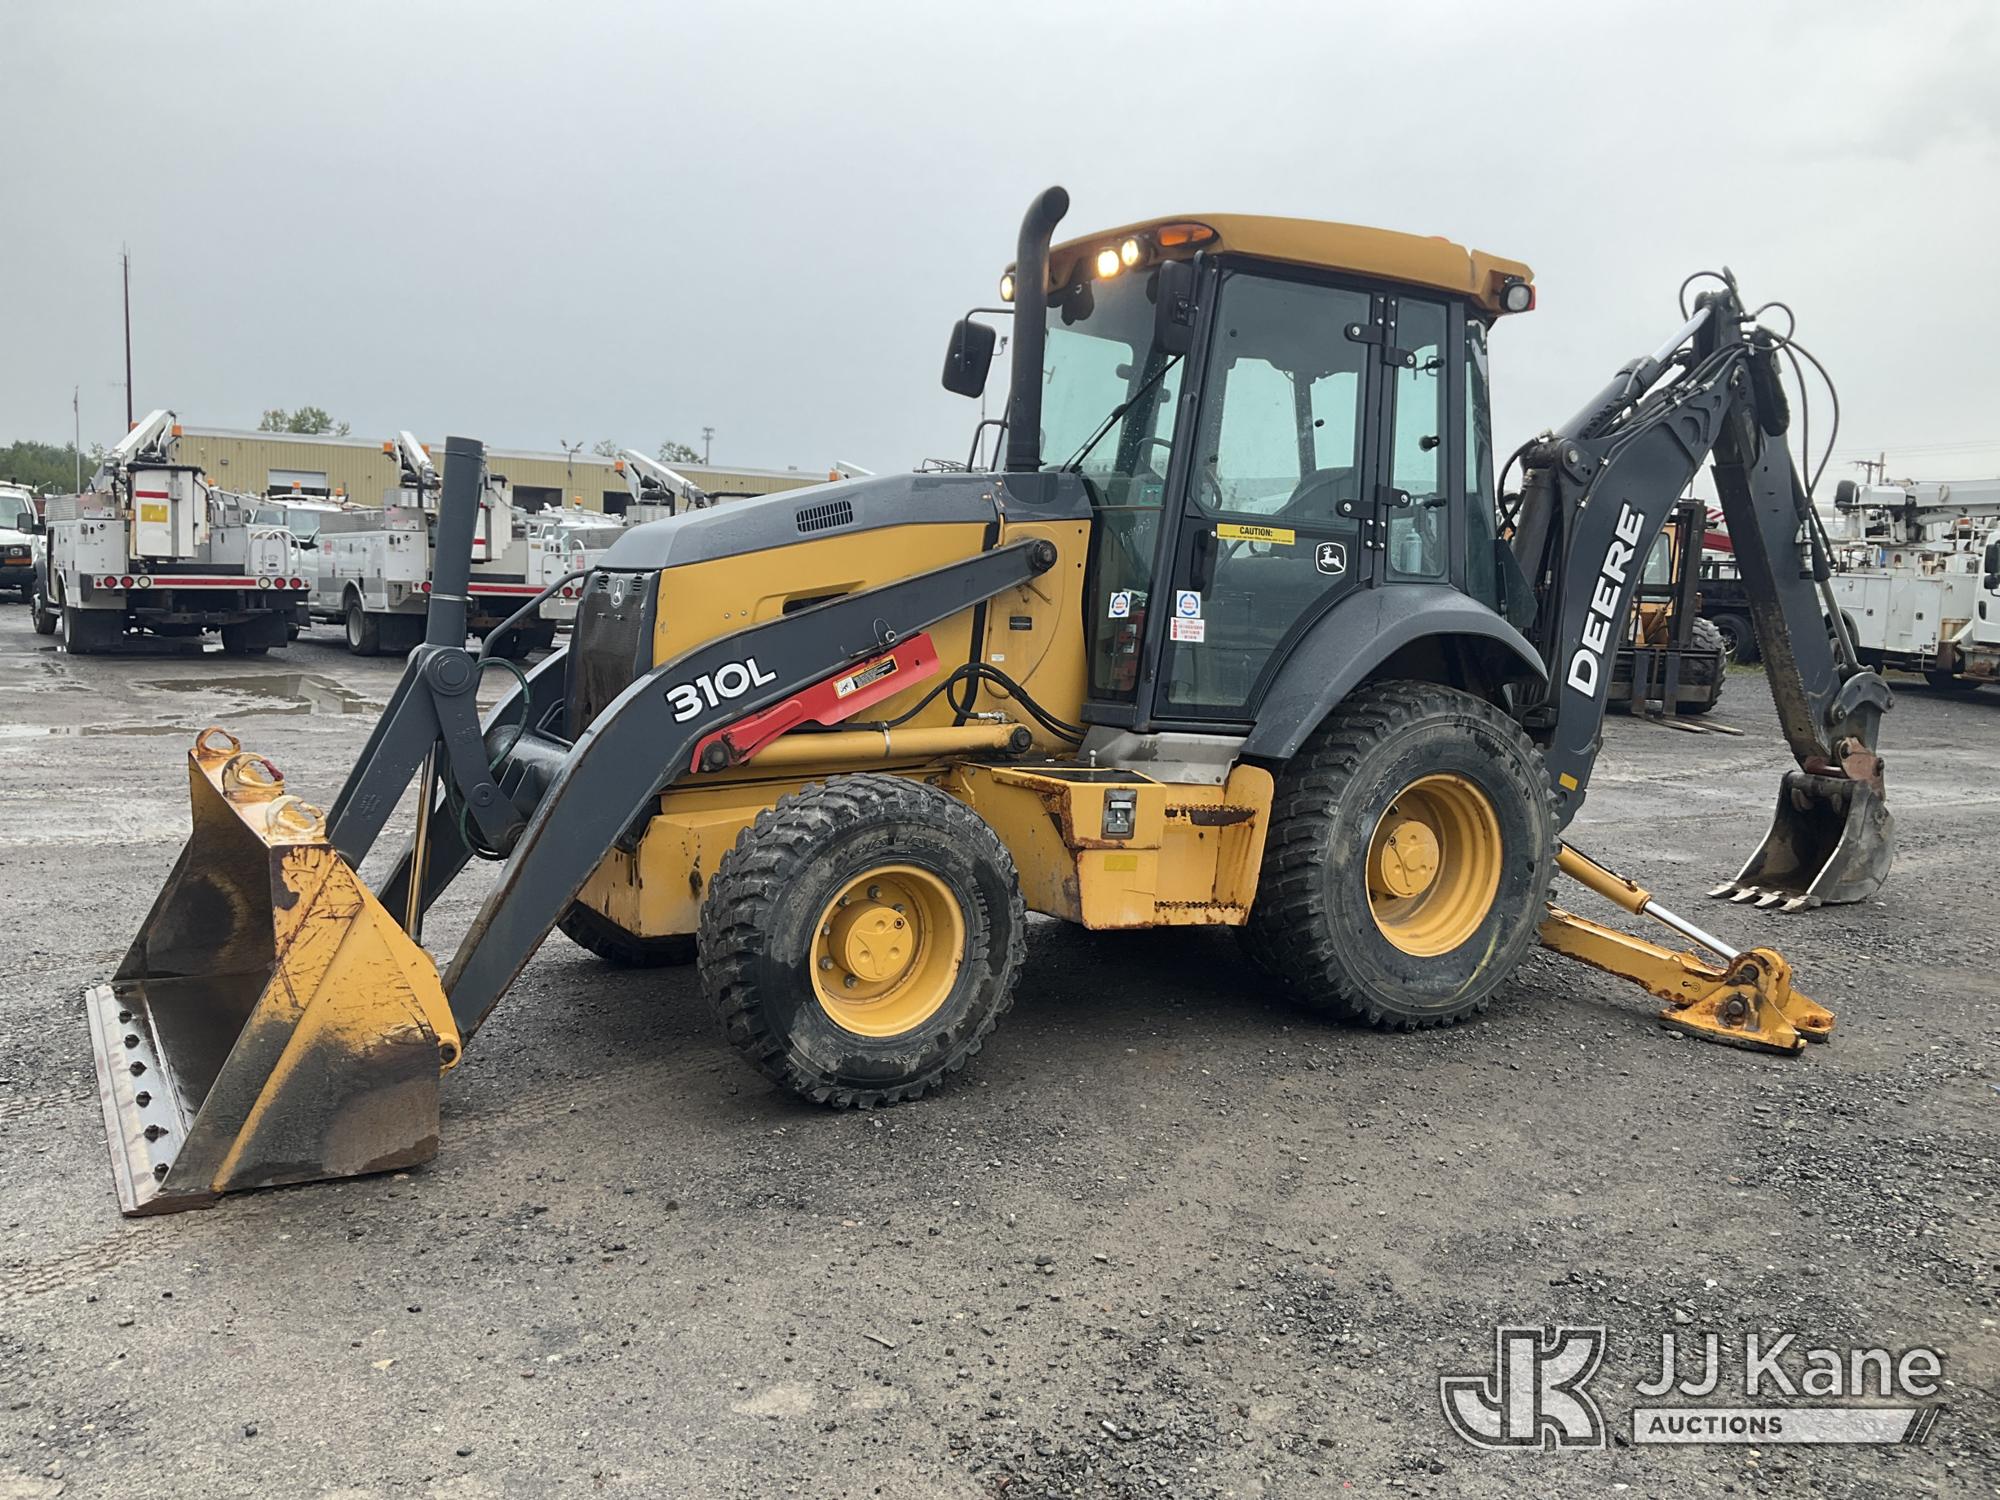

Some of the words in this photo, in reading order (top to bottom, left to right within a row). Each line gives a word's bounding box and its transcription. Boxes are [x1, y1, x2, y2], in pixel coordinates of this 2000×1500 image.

[1240, 526, 1273, 537] CAUTION:
[1567, 502, 1645, 698] DEERE
[666, 658, 777, 722] 310L
